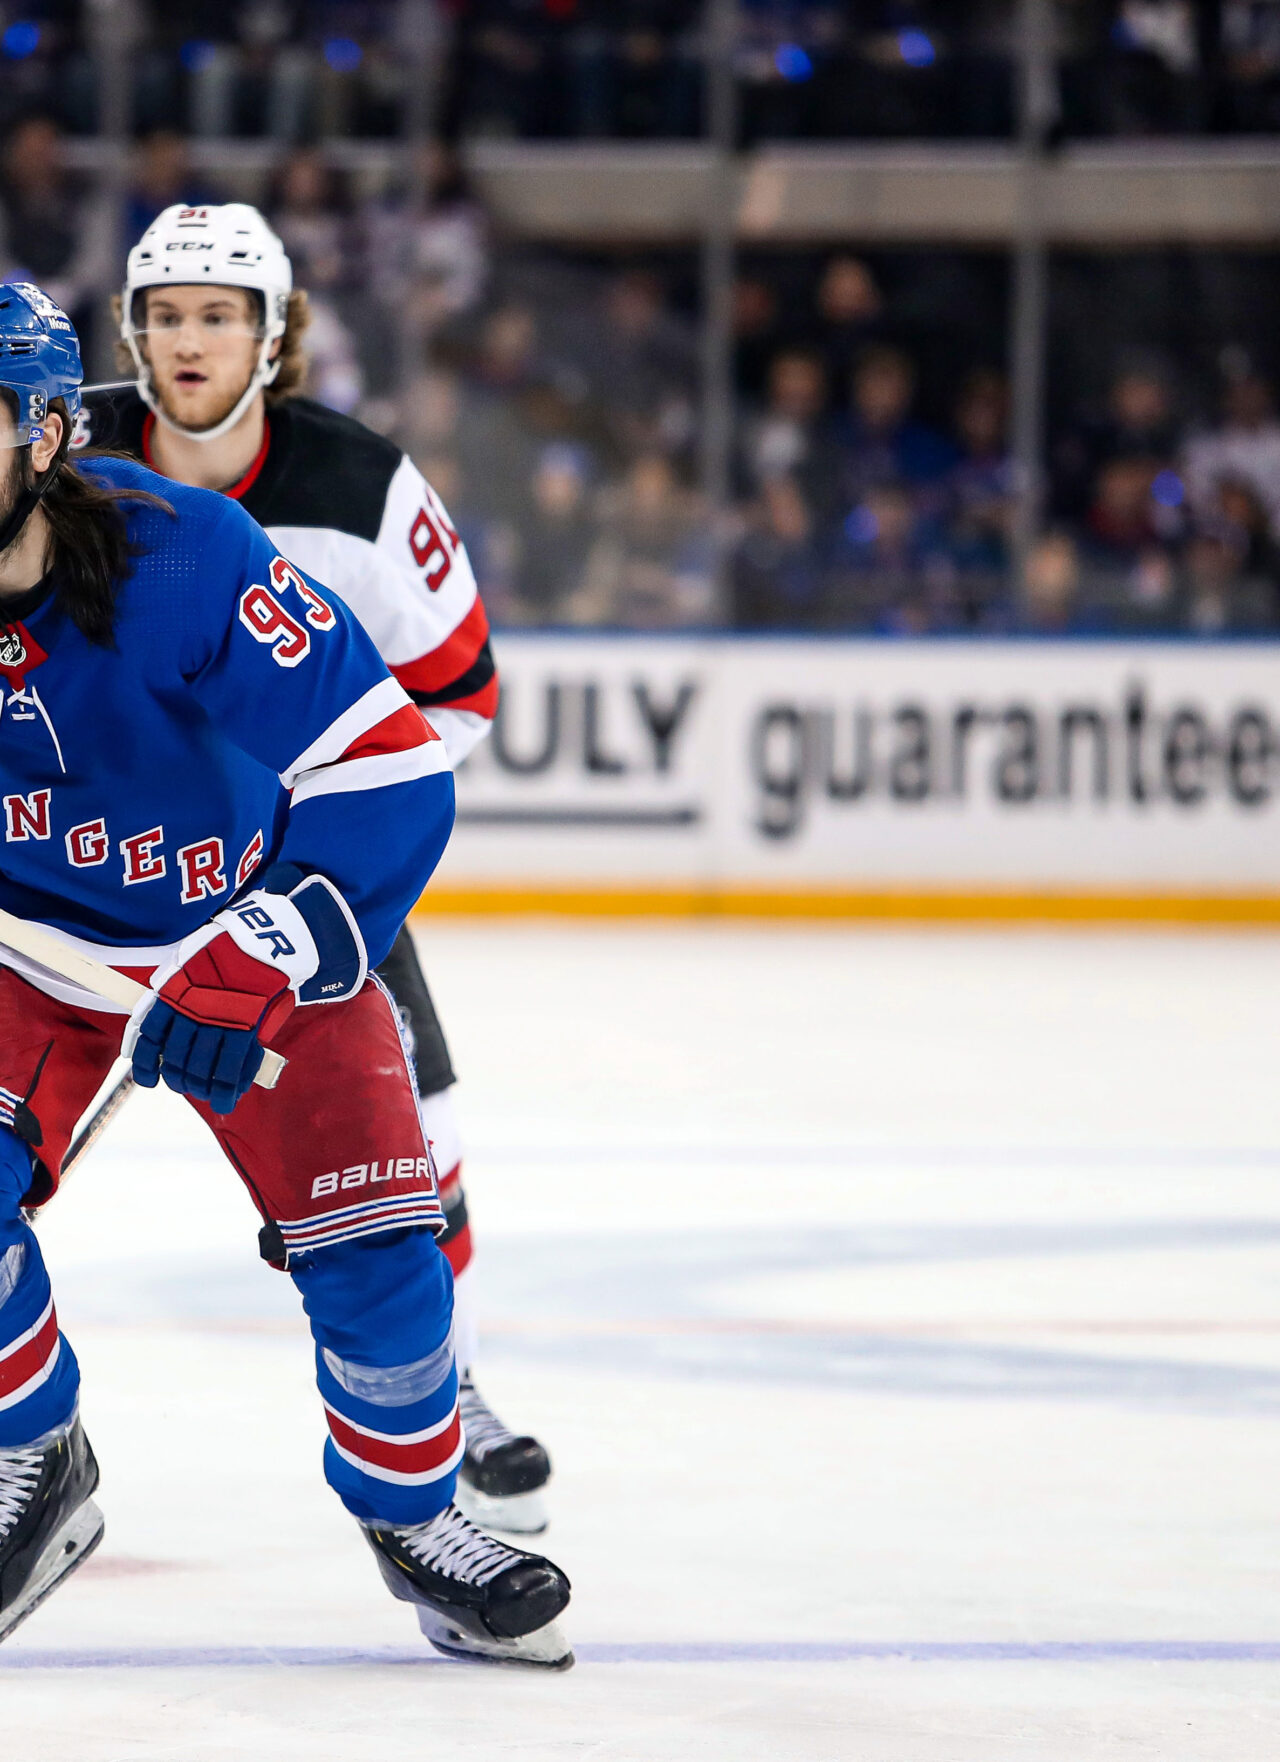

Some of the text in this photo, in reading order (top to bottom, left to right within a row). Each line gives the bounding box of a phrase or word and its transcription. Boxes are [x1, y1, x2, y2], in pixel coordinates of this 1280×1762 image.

[165, 242, 215, 251] CCM
[238, 555, 337, 668] 93
[488, 682, 696, 776] ULY
[321, 981, 344, 993] MIKA
[311, 1157, 430, 1199] BAUER
